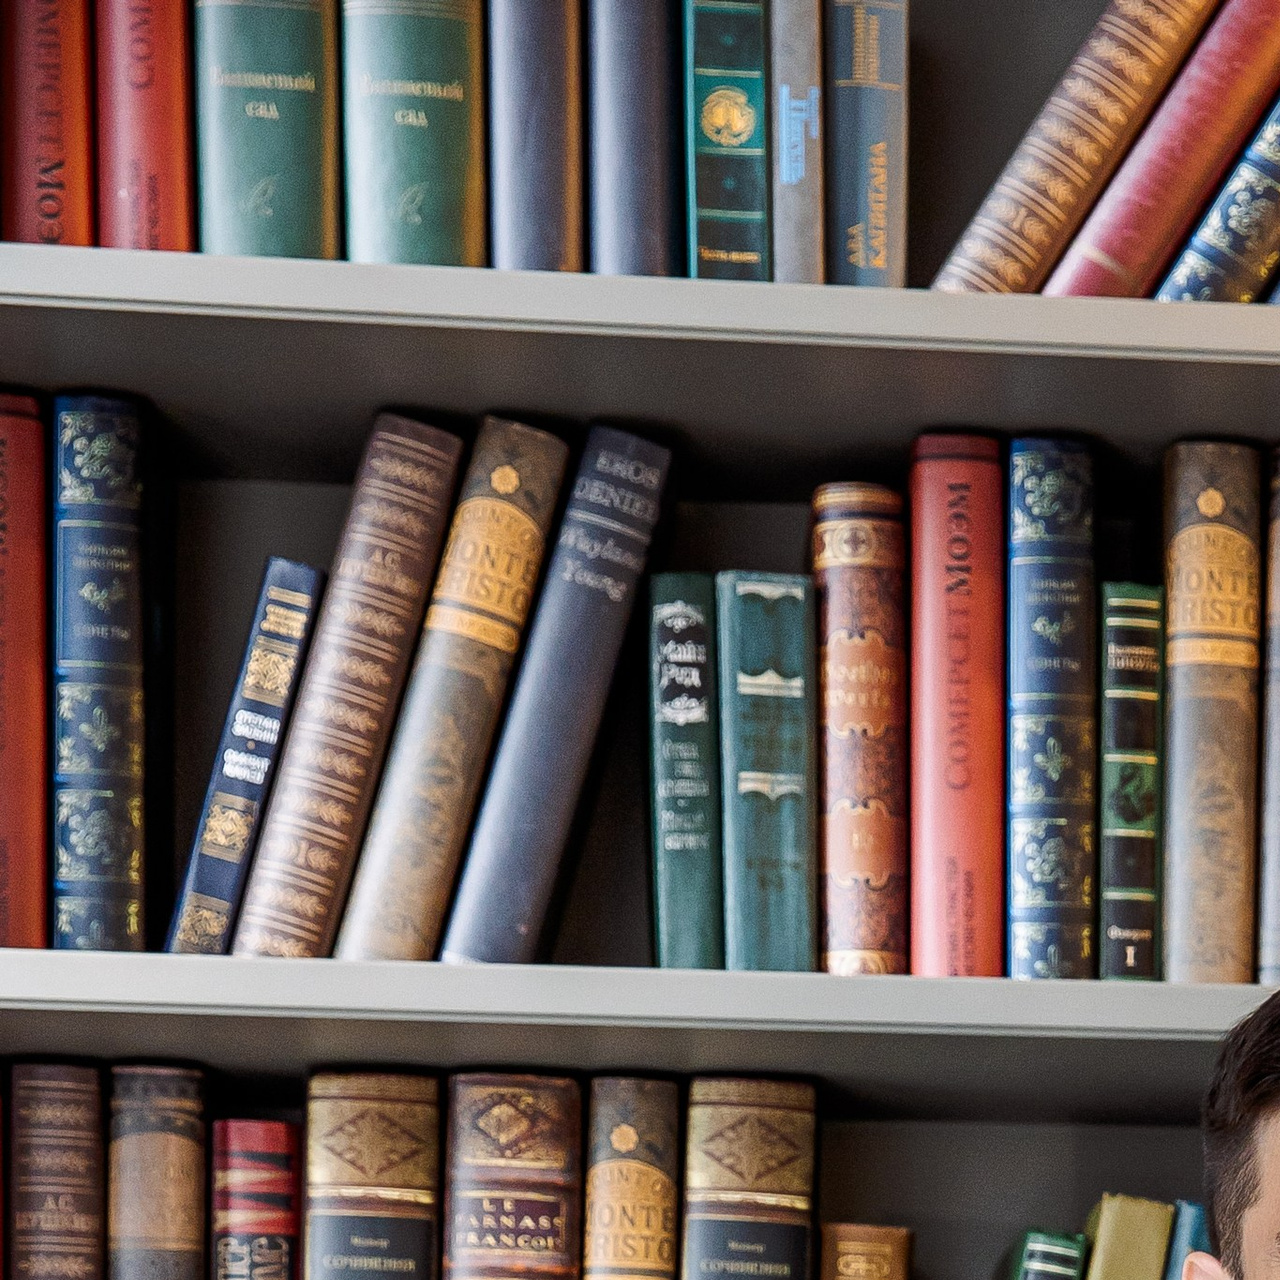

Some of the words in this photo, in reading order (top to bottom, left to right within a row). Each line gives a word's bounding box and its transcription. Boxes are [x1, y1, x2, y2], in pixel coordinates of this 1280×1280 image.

[868, 140, 888, 269] КАПИТАНА
[596, 450, 661, 490] EROS
[946, 481, 973, 596] МОЭМ
[440, 566, 530, 612] RISTO
[946, 603, 972, 791] СОМЕРСЕТ
[481, 1198, 517, 1213] LE
